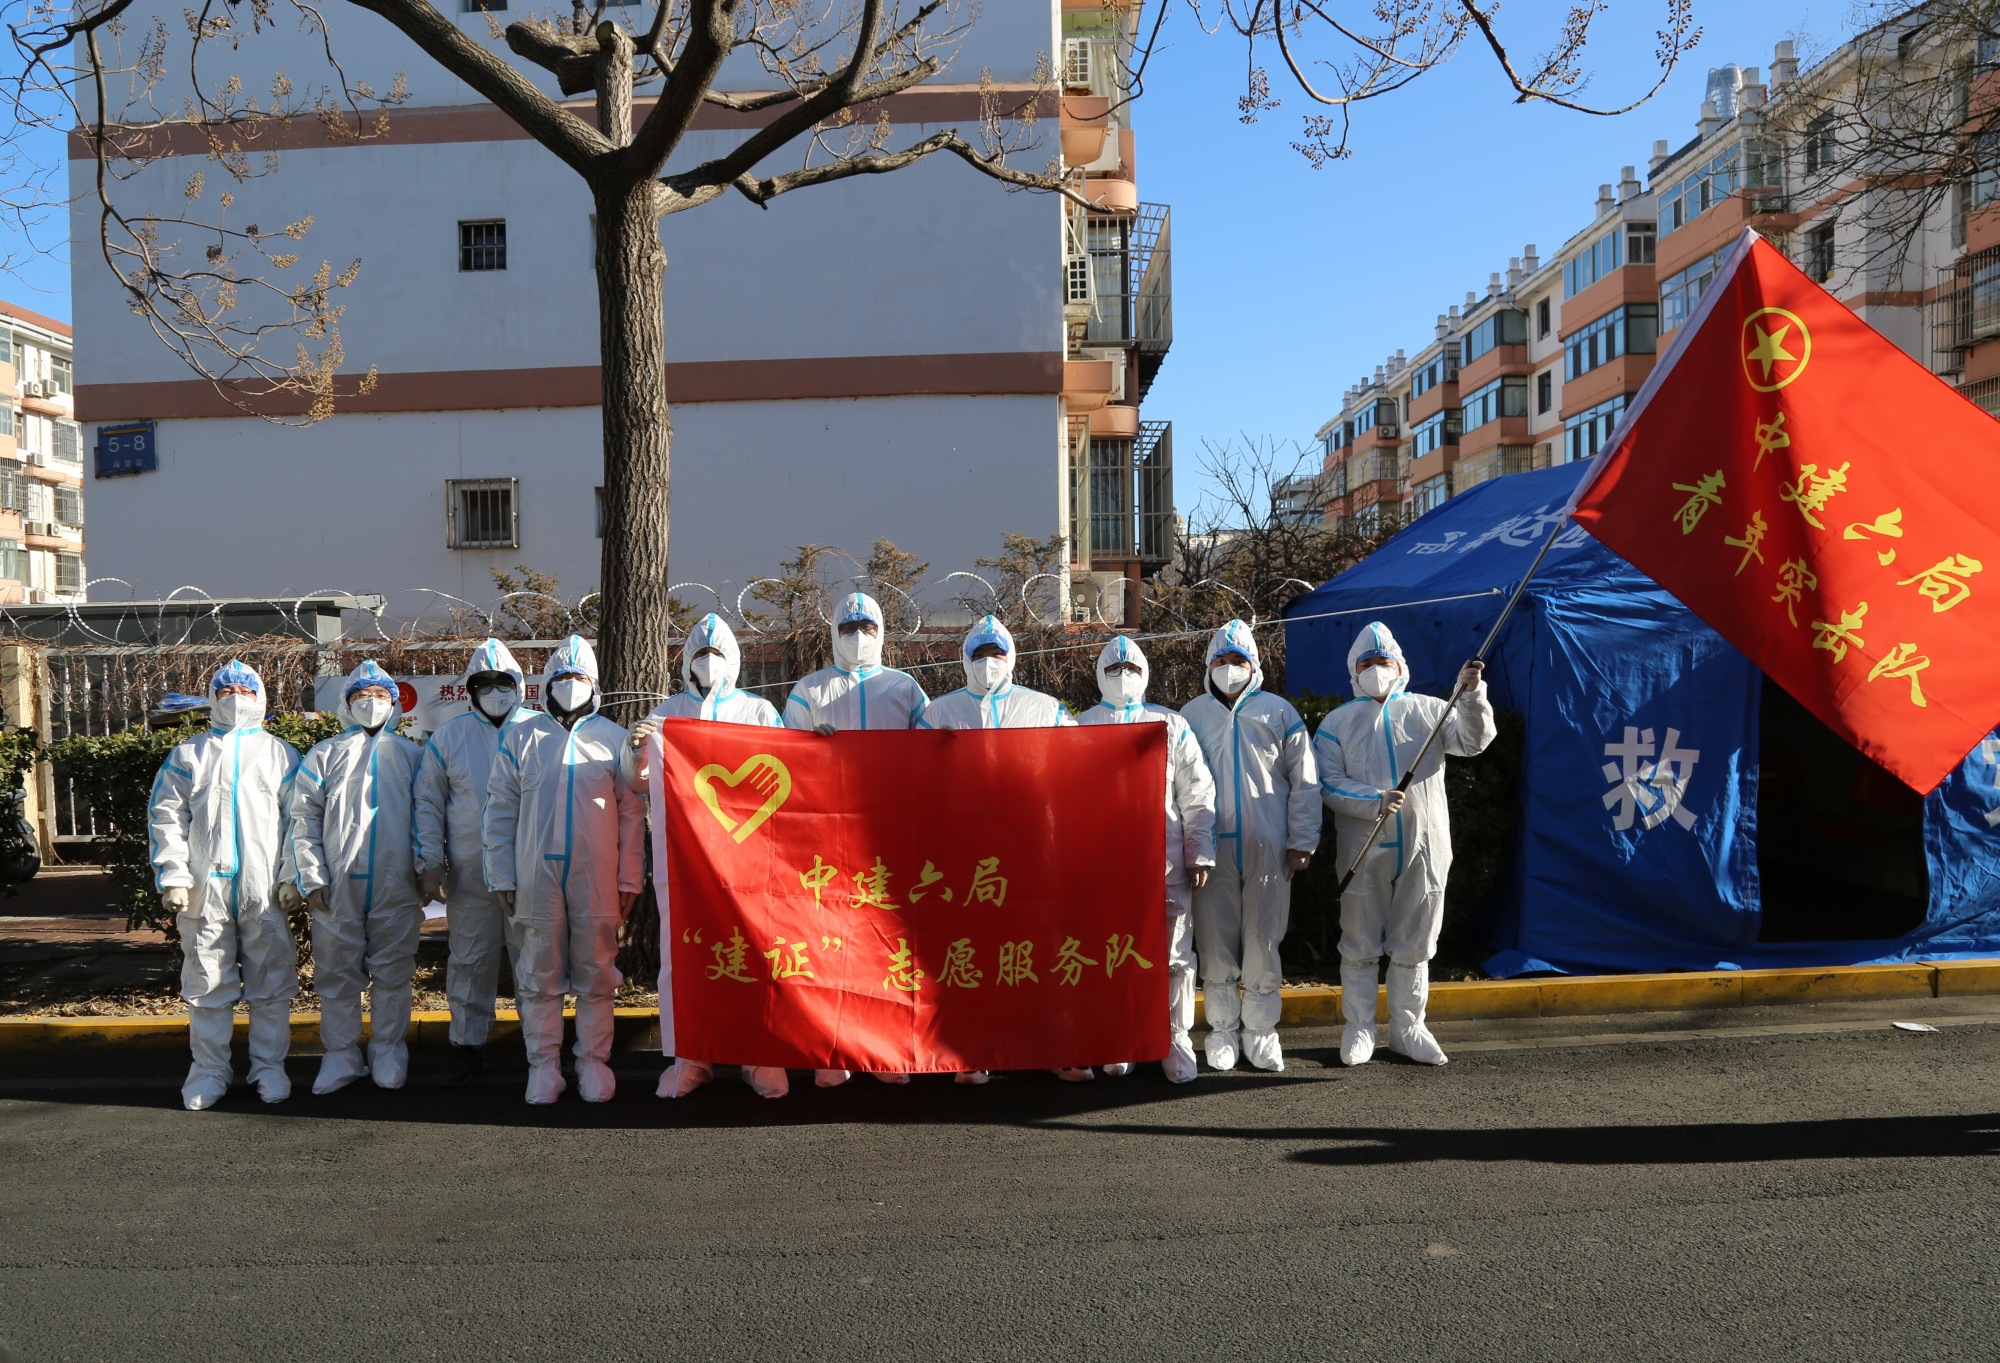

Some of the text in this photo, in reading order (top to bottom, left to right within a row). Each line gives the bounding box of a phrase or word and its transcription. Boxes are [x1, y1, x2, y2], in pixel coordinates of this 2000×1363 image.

[108, 435, 146, 453] 5-8
[1753, 411, 1984, 615] 中建六局
[1672, 468, 1931, 708] 青年突击队
[1601, 725, 1700, 832] 救
[798, 855, 1009, 911] 中建六局
